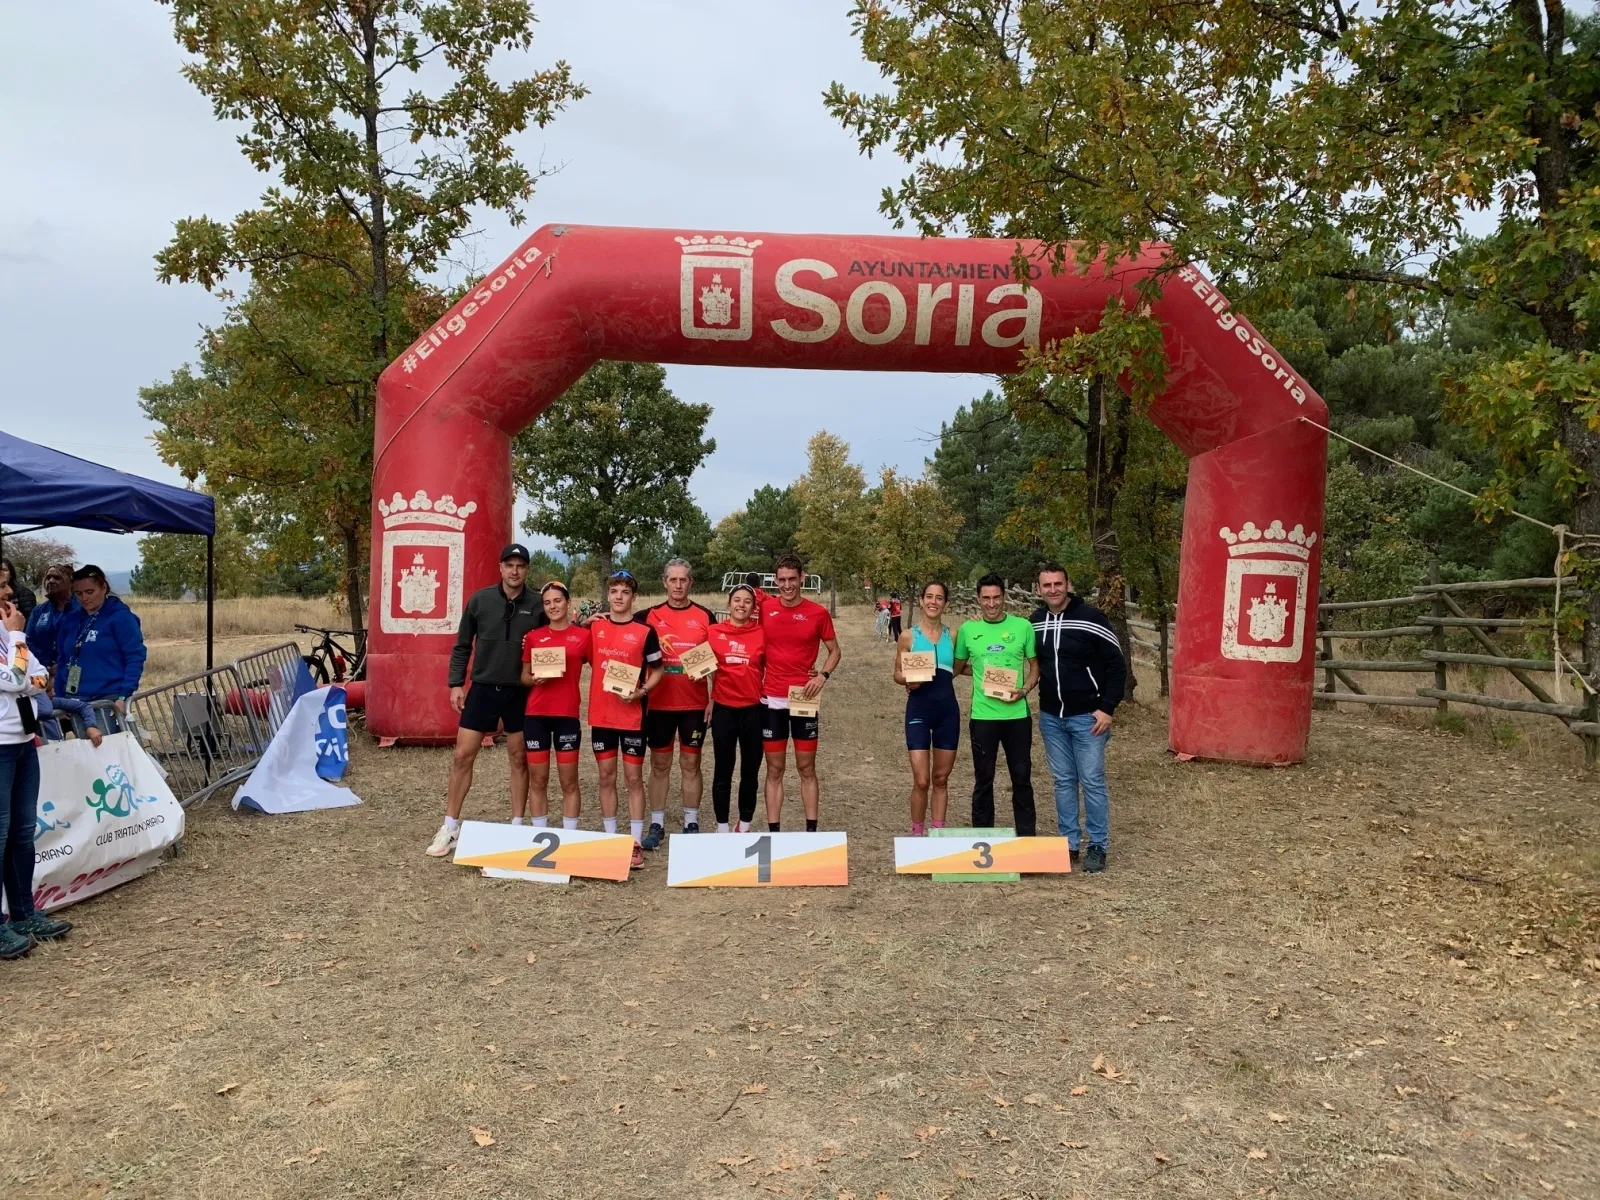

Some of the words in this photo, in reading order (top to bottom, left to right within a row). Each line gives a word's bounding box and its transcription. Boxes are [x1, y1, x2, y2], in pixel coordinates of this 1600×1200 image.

[848, 260, 1042, 280] AYUNTAMIENO
[402, 247, 542, 374] #EligeSoria
[770, 258, 1043, 348] Soria
[1178, 267, 1306, 405] #EligeSoria
[96, 832, 113, 846] CLUB
[527, 832, 560, 869] 2
[745, 836, 771, 882] 1
[972, 842, 993, 868] 3
